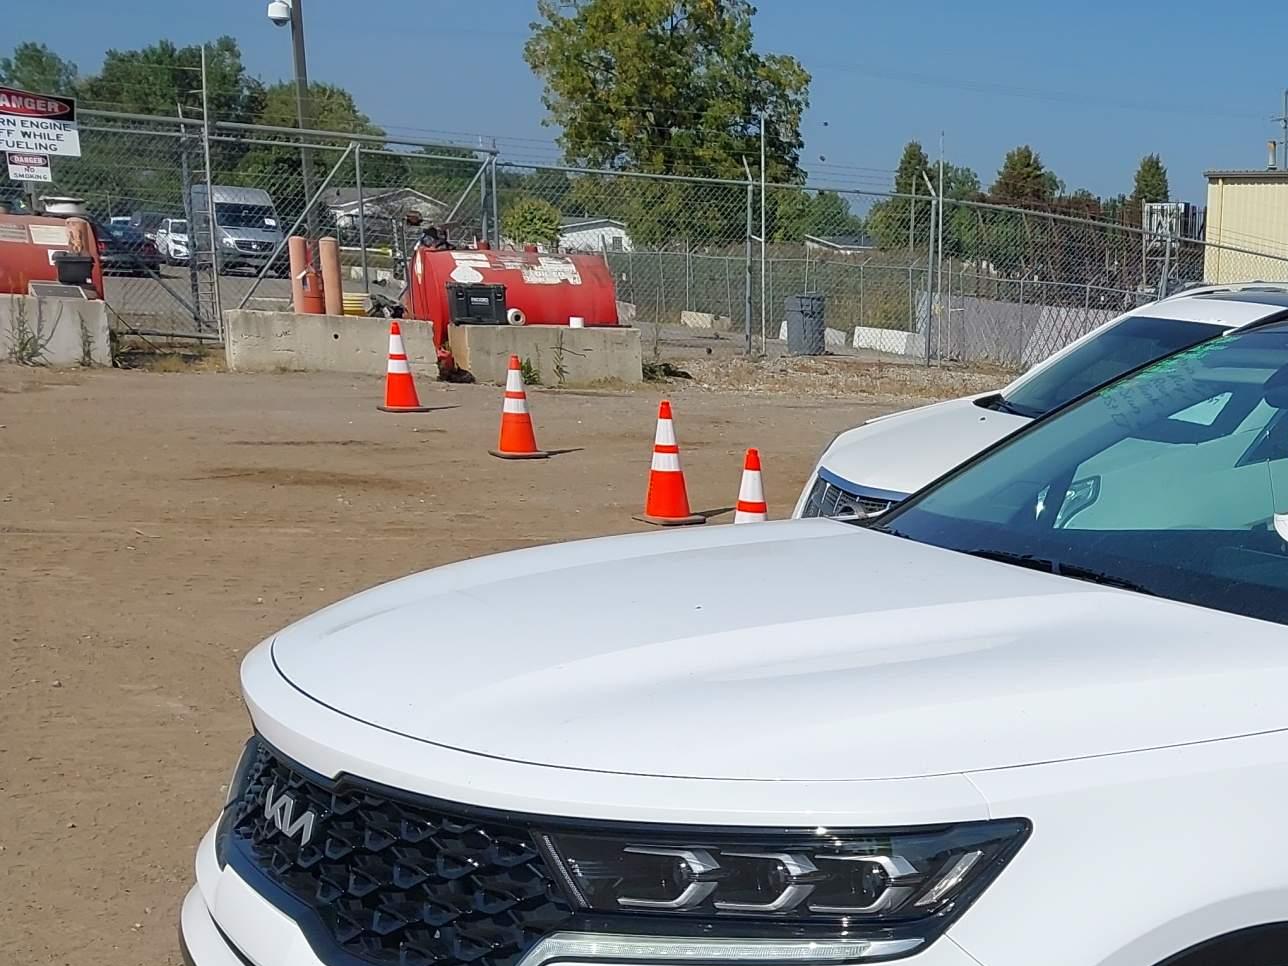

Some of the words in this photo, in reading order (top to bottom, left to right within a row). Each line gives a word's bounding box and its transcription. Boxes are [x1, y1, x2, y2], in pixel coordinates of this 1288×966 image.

[0, 93, 59, 112] ANGER
[0, 117, 16, 126] RN
[21, 120, 71, 132] ENGINE
[20, 130, 64, 142] WHILE
[14, 155, 43, 164] DANGER
[13, 172, 48, 180] SMOKING
